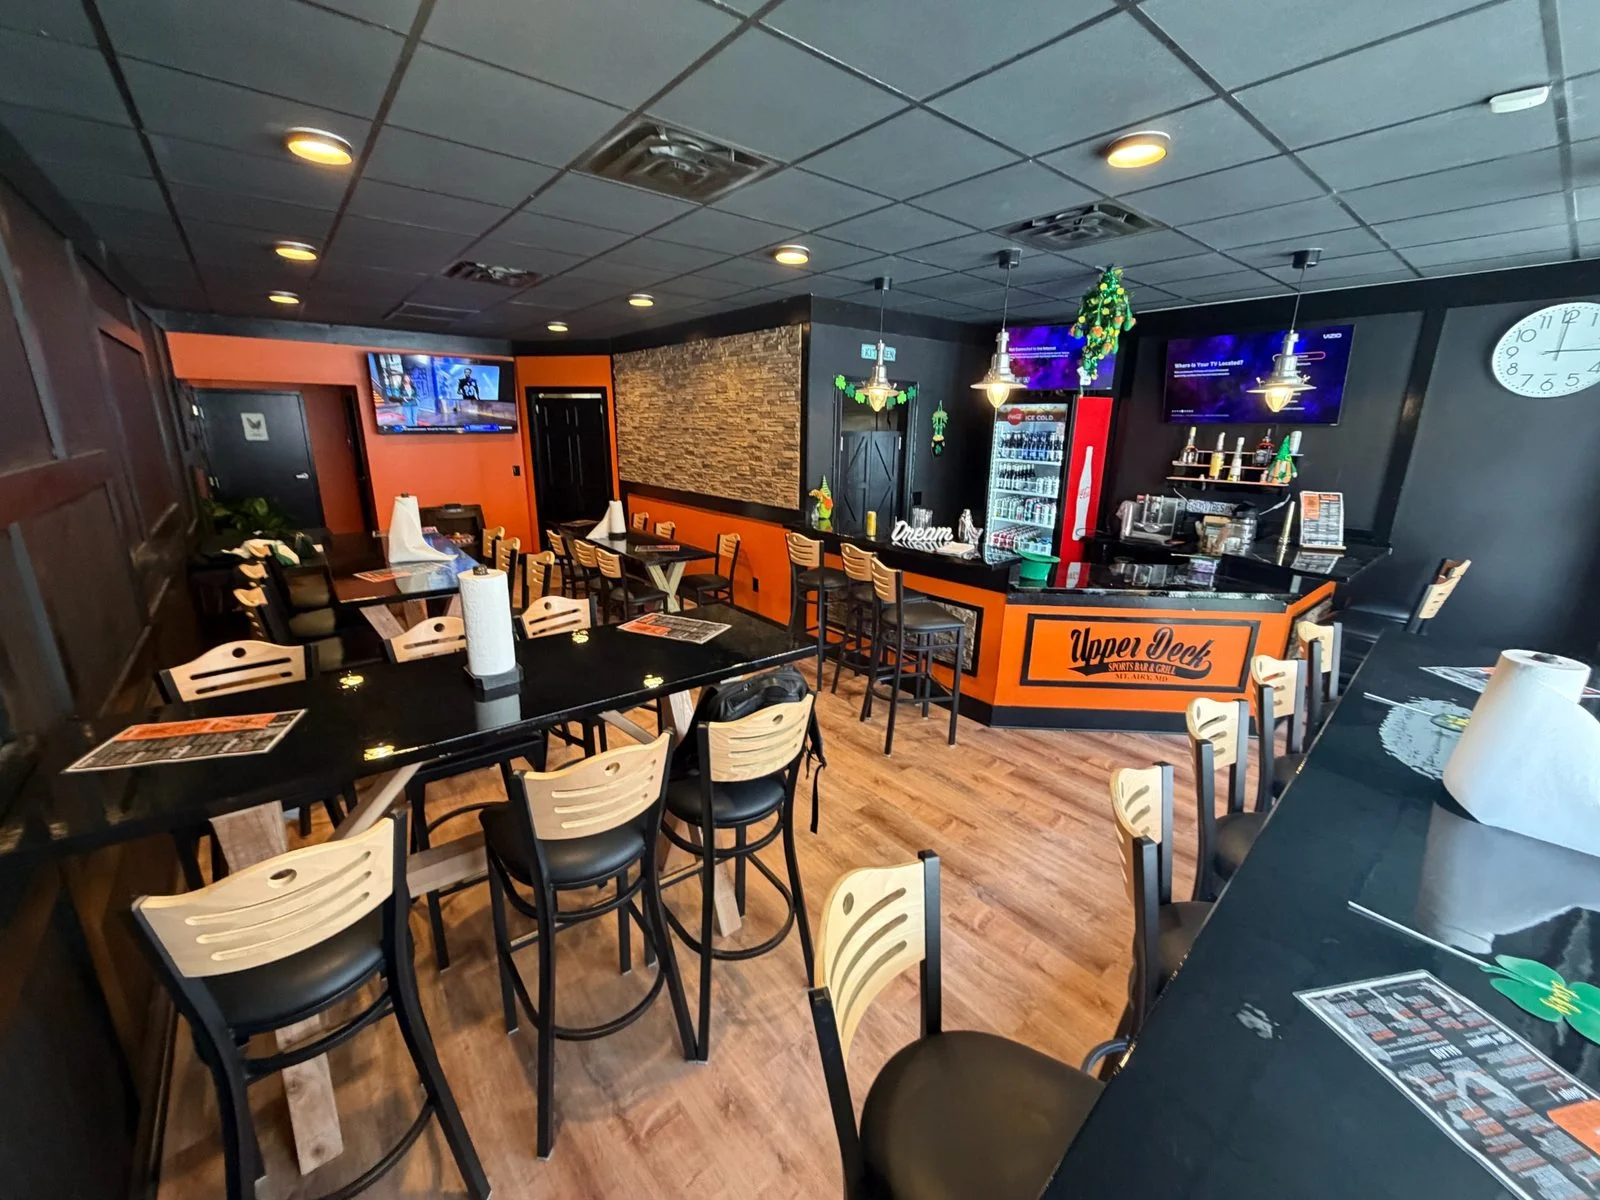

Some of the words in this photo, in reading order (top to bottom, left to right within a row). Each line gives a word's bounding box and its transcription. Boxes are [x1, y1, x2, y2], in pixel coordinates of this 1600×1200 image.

[1540, 315, 1553, 329] 11
[1561, 309, 1580, 324] 12
[1591, 312, 1599, 327] 1
[1516, 329, 1537, 342] 10
[864, 347, 895, 359] KITEN
[1506, 346, 1519, 359] 9
[1506, 362, 1518, 375] 8
[1521, 373, 1534, 387] 7
[1540, 378, 1554, 391] 6
[1565, 373, 1580, 387] 5
[891, 519, 953, 541] Dream
[1070, 626, 1141, 667] Upper
[1146, 626, 1215, 669] Deck
[1108, 662, 1134, 672] SPORTS
[1134, 662, 1149, 672] BAR
[1148, 662, 1155, 672] &
[1155, 663, 1176, 675] GRILL
